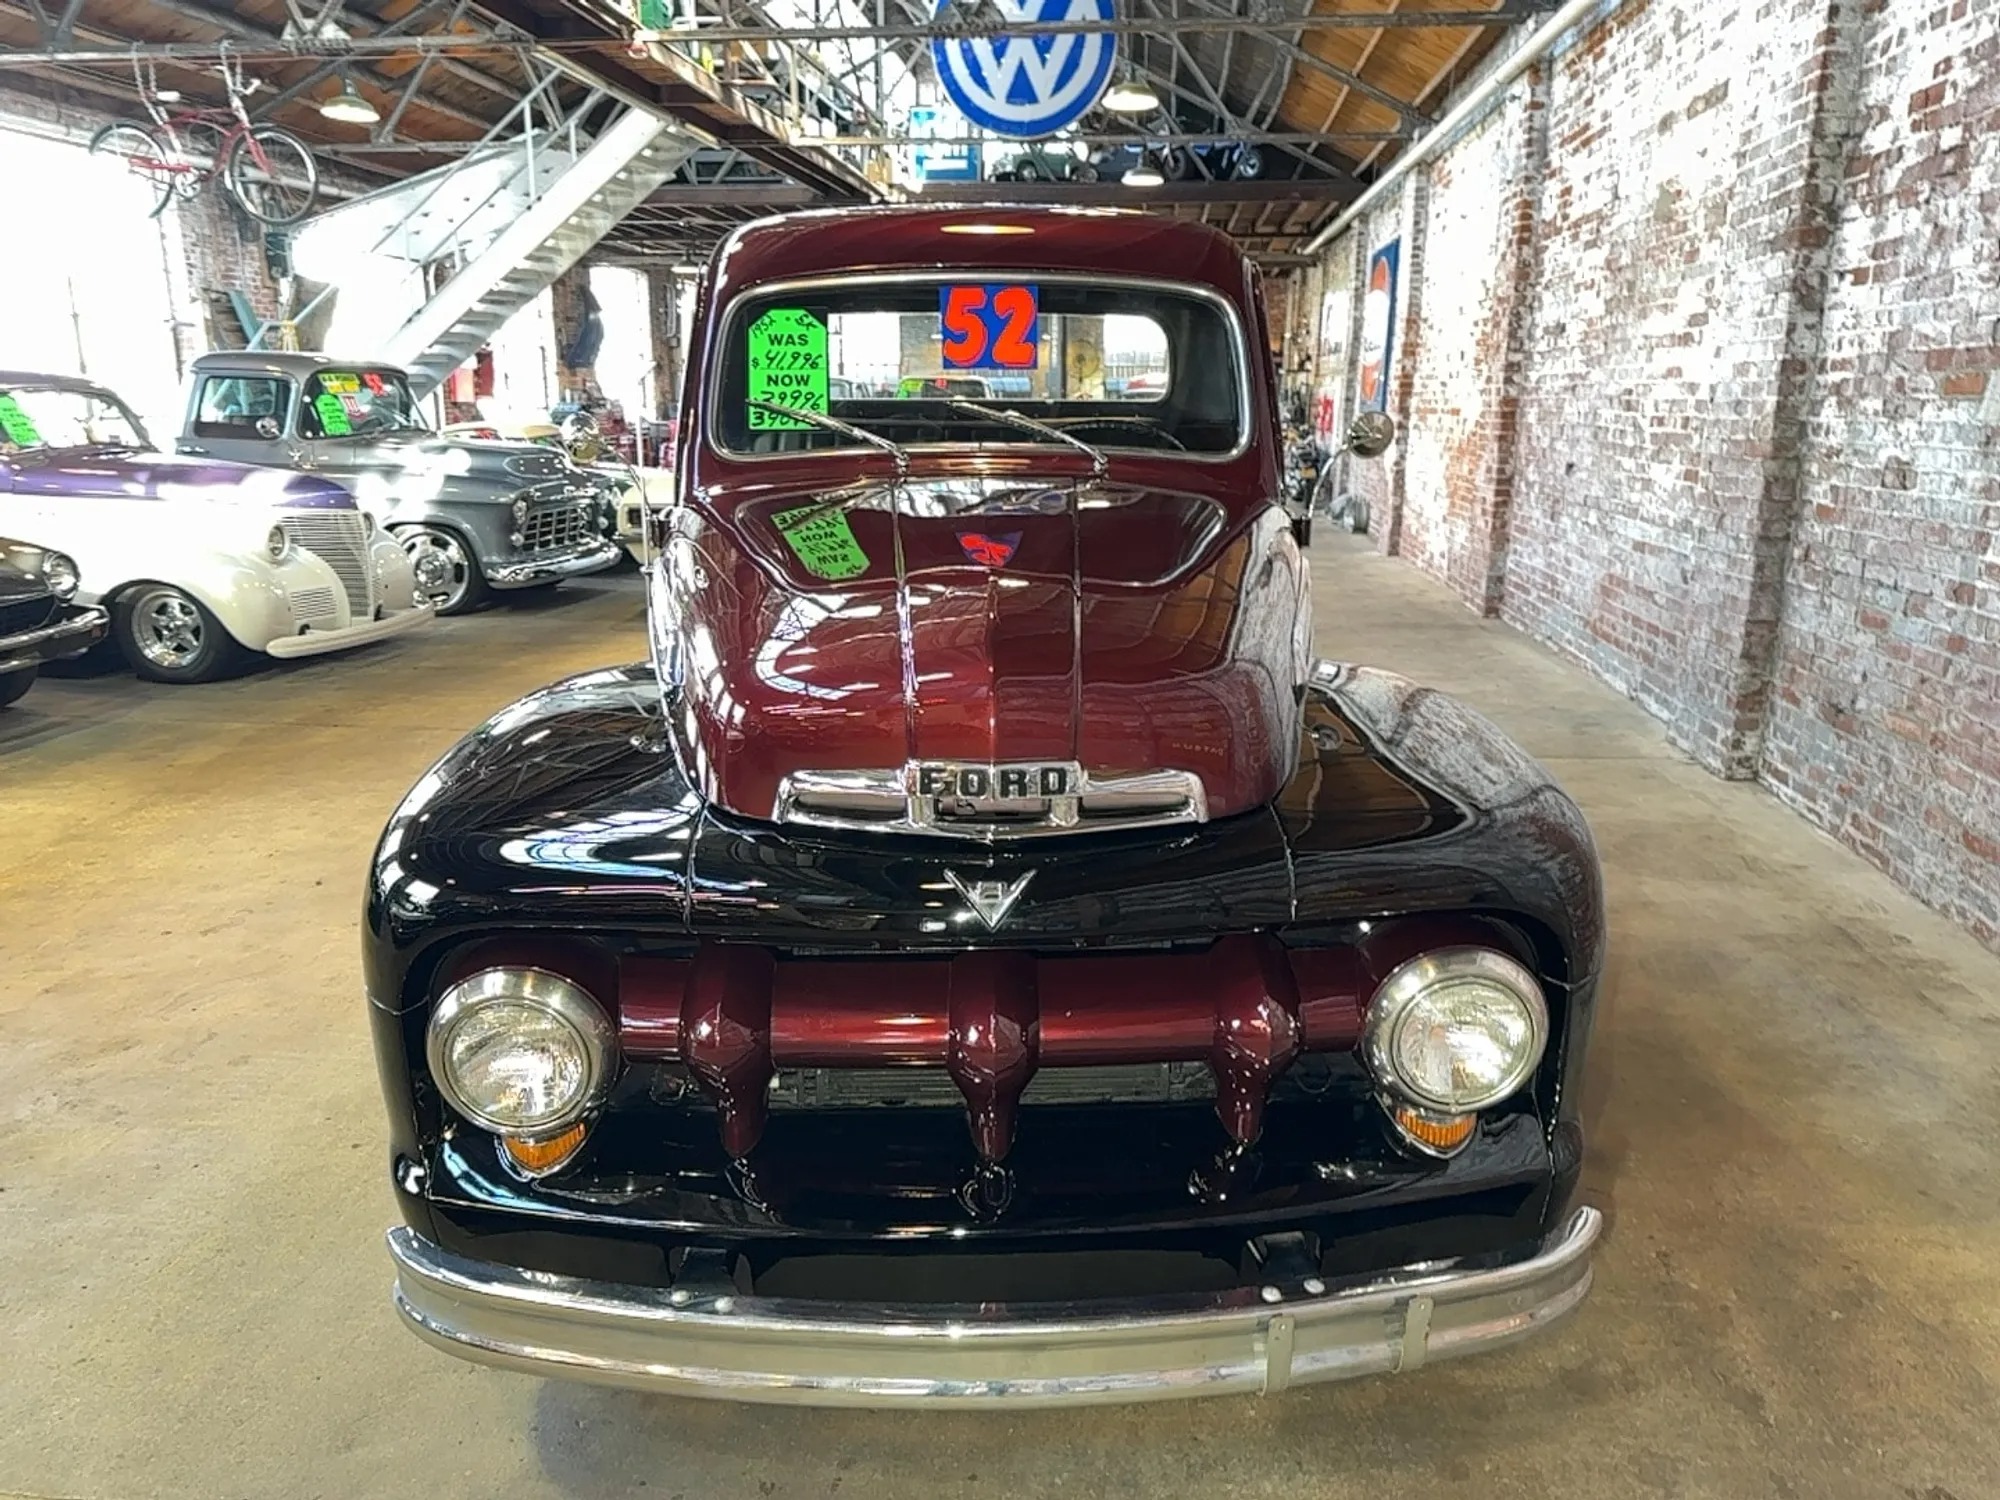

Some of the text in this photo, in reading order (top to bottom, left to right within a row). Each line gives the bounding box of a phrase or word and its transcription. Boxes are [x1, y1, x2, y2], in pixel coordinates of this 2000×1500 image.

[942, 286, 1036, 368] 52
[767, 333, 809, 346] WAS
[766, 374, 811, 387] NOW
[918, 766, 1067, 798] FORD
